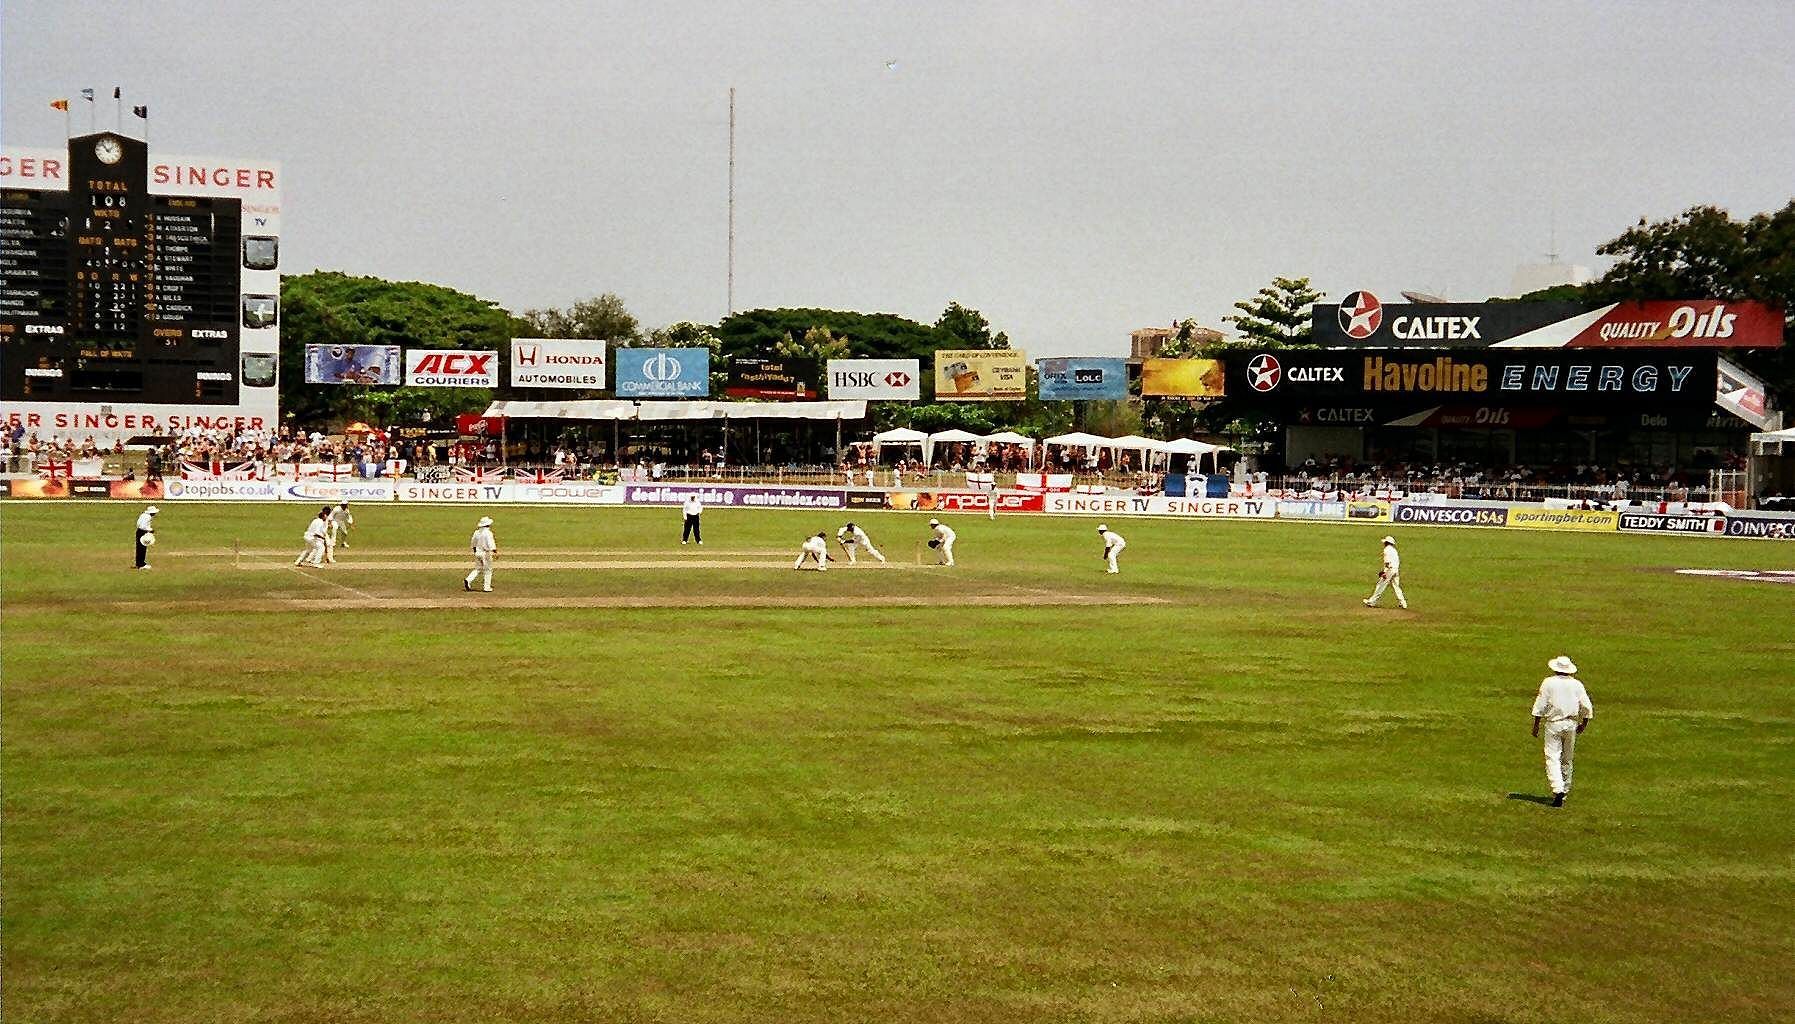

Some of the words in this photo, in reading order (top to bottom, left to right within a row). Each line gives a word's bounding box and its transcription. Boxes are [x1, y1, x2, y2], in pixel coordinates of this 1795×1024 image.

[153, 165, 275, 189] SINGER
[89, 181, 128, 191] TOTAL
[254, 217, 267, 226] TV
[25, 325, 64, 334] EXTRAS
[1391, 315, 1482, 340] CALTEX
[1599, 321, 1662, 341] QUALITY
[1667, 304, 1738, 339] Oils
[191, 329, 228, 338] EXTRAS
[412, 354, 493, 375] ACX
[545, 355, 604, 366] HONDA
[414, 376, 490, 385] COURIERS
[518, 374, 597, 384] AUTOMOBILES
[835, 371, 880, 388] HSBC
[1286, 366, 1345, 383] CALTEX
[1363, 355, 1489, 393] Havoline
[1500, 365, 1694, 392] ENERGY
[55, 413, 158, 429] SINGER
[168, 415, 264, 431] SINGER
[1316, 407, 1376, 423] CALTEX
[184, 483, 276, 497] topjobs.co.uk
[304, 486, 387, 497] freeserve
[408, 487, 479, 500] SINGER
[482, 486, 503, 500] TV
[742, 491, 840, 507] cantorindex.com
[1054, 499, 1127, 512] SINGER
[1131, 498, 1150, 512] TV
[1168, 501, 1239, 514] SINGER
[1244, 501, 1264, 515] TV
[1514, 511, 1613, 526] sportingbet.com
[1624, 516, 1663, 528] TEDDY
[1666, 518, 1706, 531] SMITH
